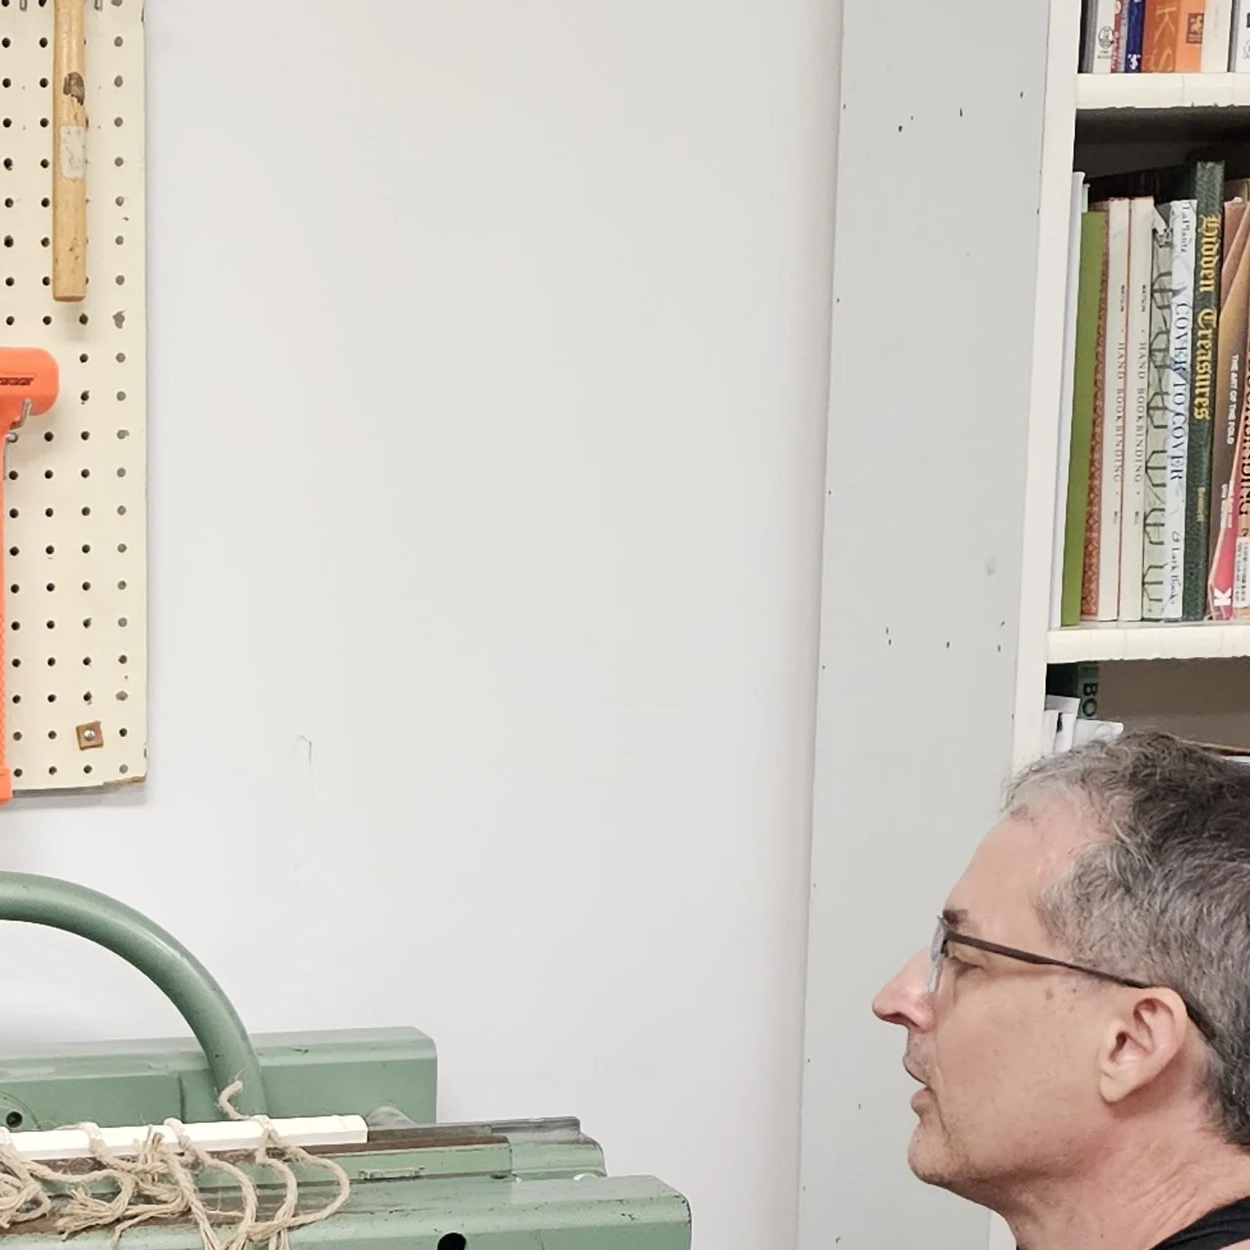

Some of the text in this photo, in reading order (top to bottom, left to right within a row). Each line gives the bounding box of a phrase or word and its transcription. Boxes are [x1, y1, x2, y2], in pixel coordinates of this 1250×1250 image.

[1193, 212, 1222, 420] Hidden Treasures
[1113, 342, 1126, 482] HAND BOOKBINDING
[1134, 342, 1147, 482] HAND BOOKBINDING
[1170, 302, 1190, 480] COVER TO COVER
[1226, 354, 1239, 445] THE ART OF THE FOLD
